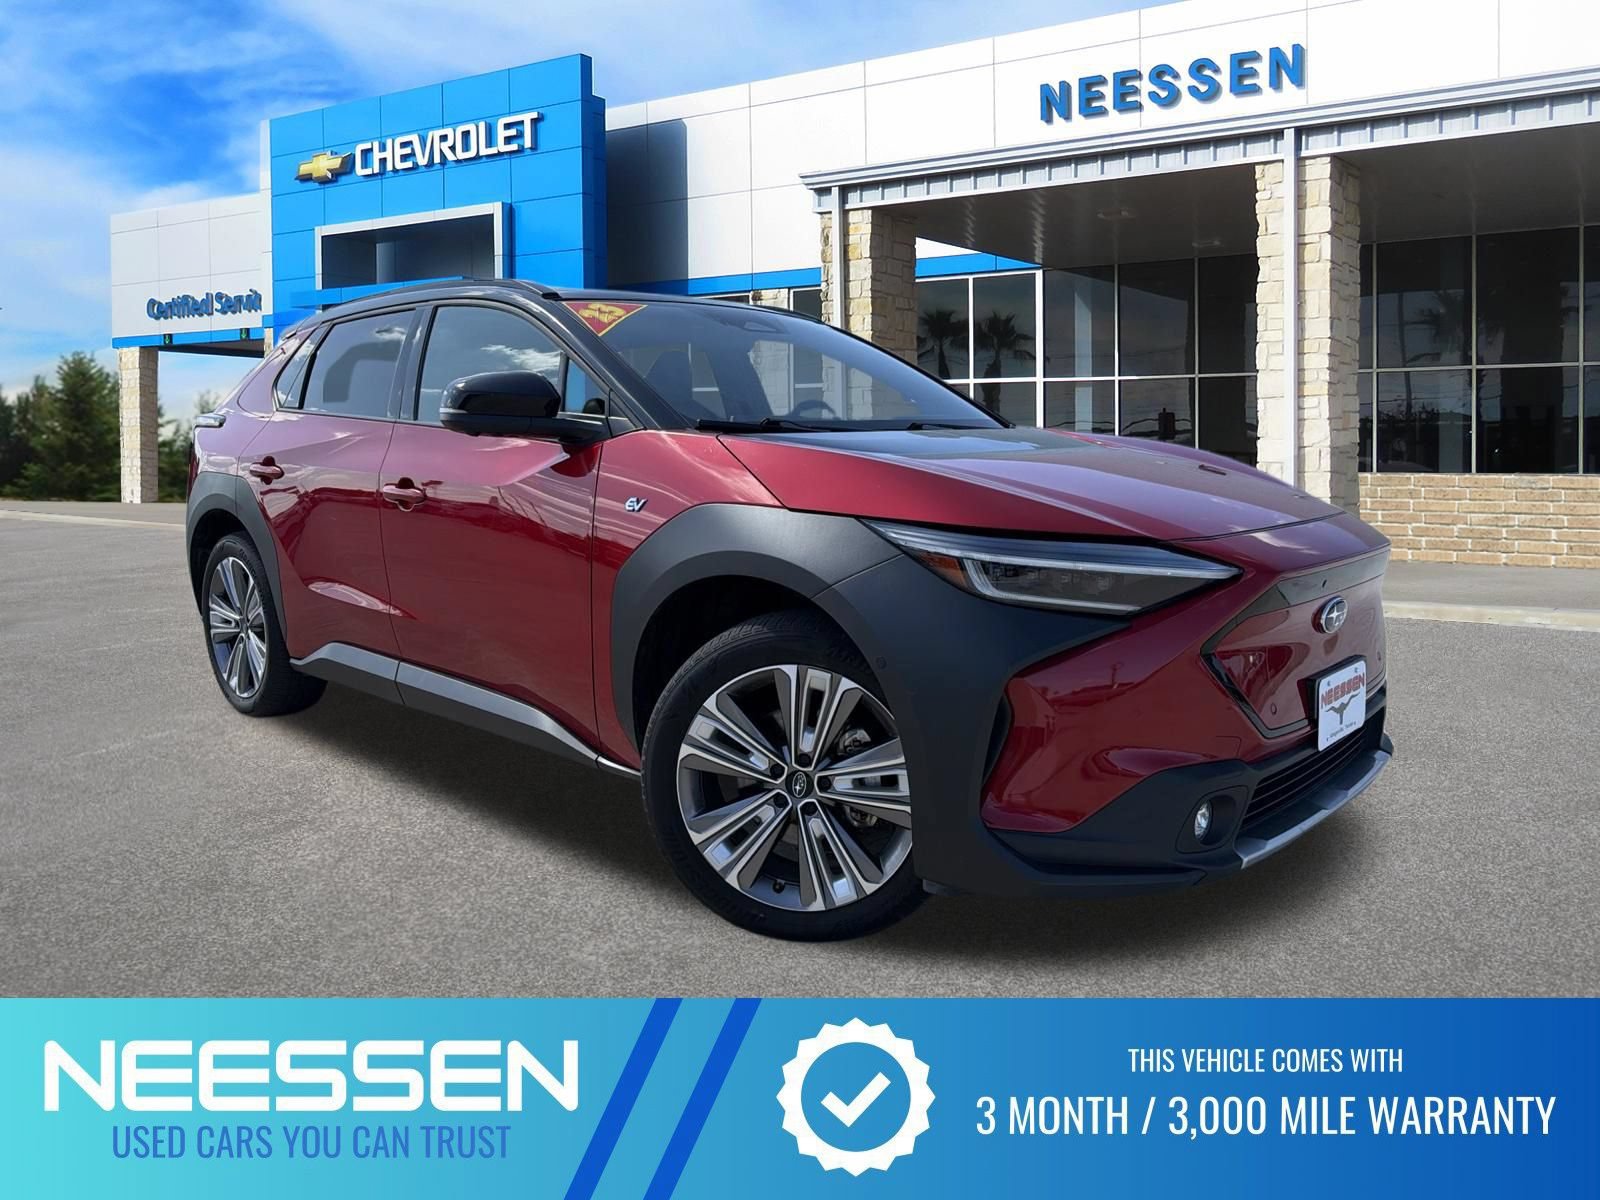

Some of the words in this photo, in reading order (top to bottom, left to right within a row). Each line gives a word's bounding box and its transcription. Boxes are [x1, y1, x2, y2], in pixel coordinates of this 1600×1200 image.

[1040, 44, 1304, 123] NEESSEN
[354, 111, 542, 177] CHEVROLET
[147, 292, 214, 320] Certified
[625, 497, 648, 512] EV
